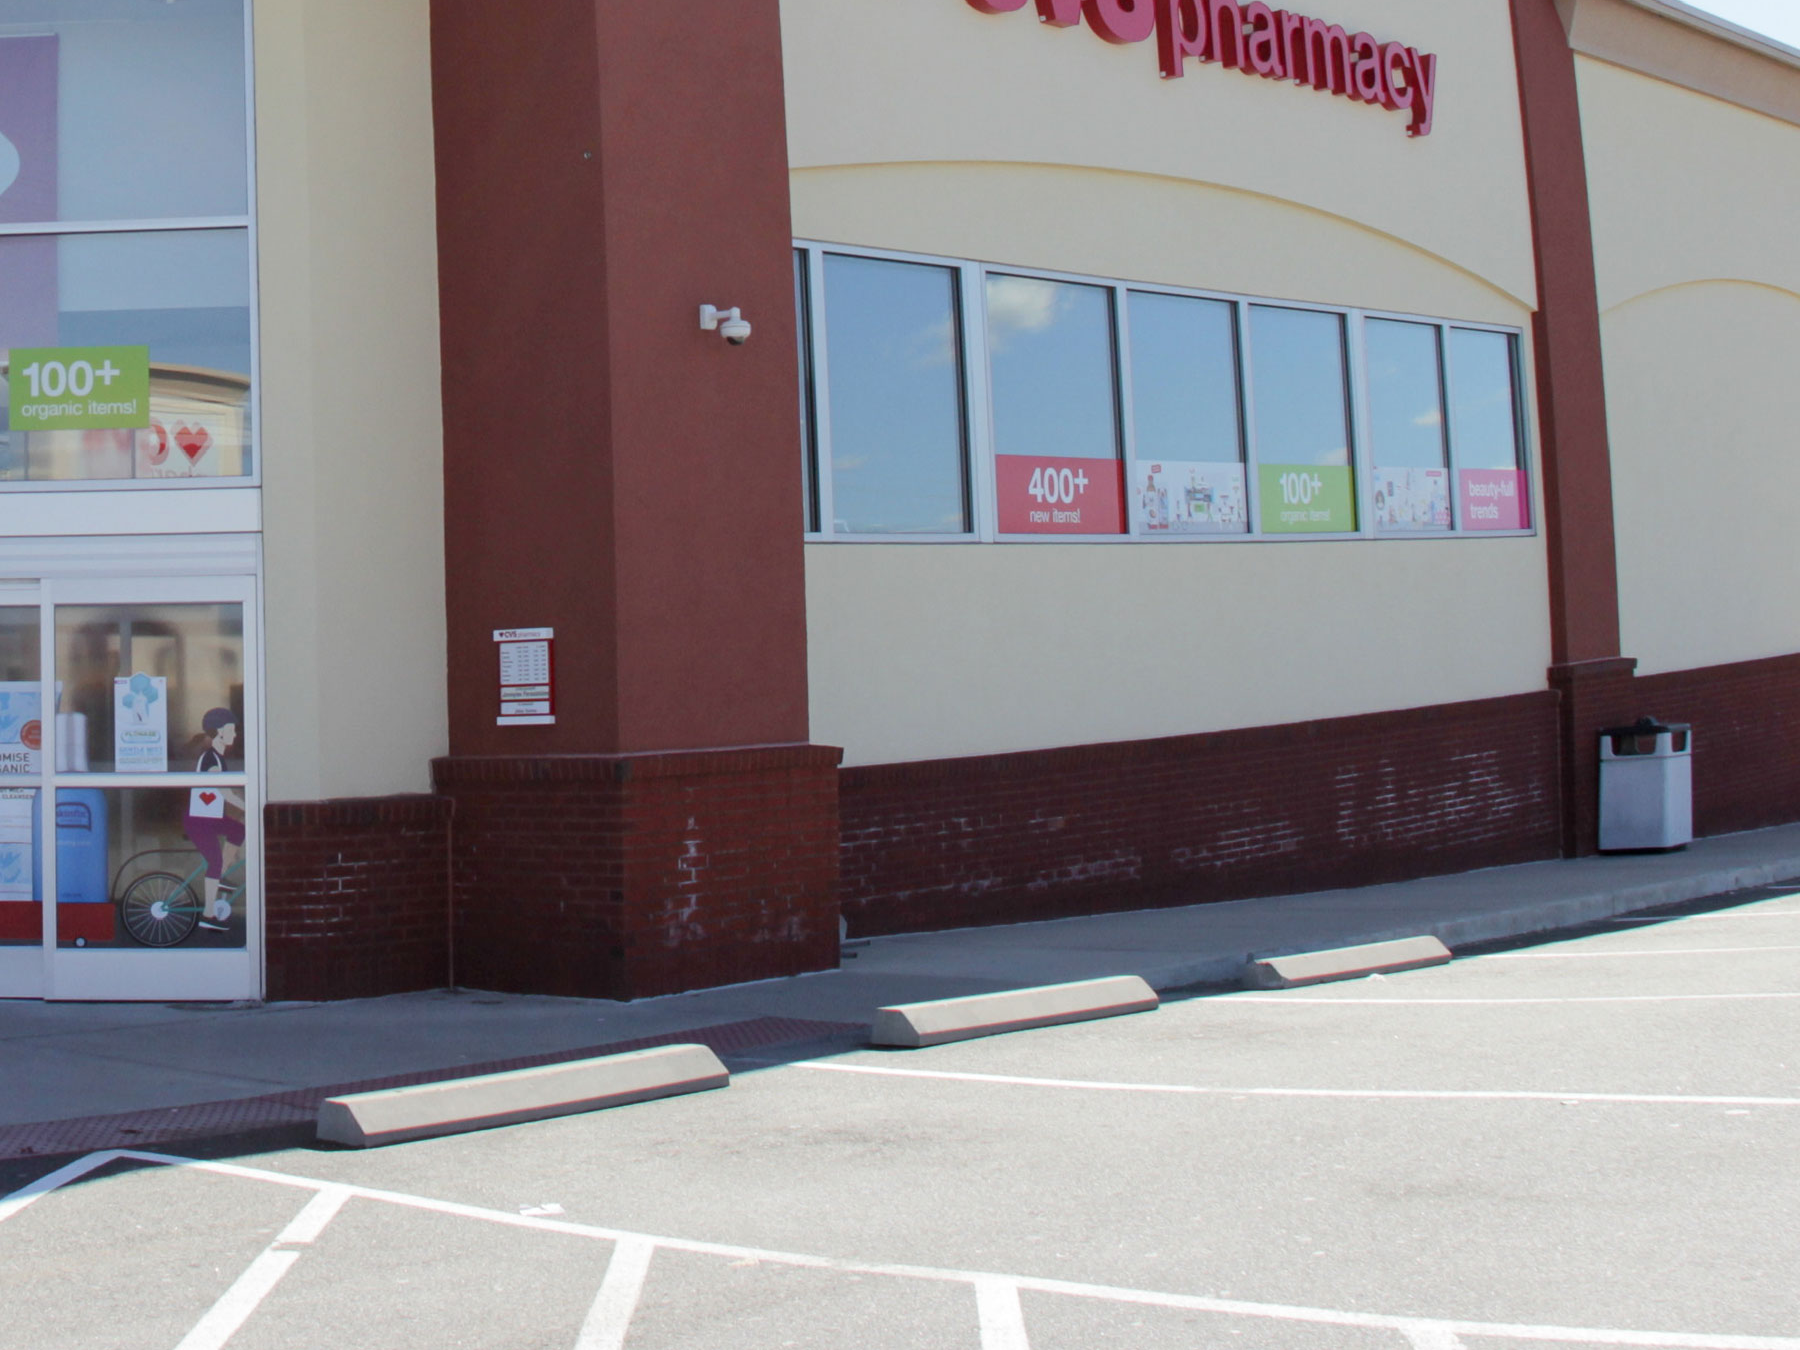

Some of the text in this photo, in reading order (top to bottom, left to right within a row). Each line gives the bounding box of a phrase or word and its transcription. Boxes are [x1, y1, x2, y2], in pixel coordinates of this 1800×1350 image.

[22, 360, 121, 397] 100+
[21, 398, 138, 420] organic items!
[1028, 467, 1089, 505] 400+
[1279, 472, 1323, 505] 100+
[1029, 509, 1081, 523] new items!
[1470, 503, 1499, 519] trends
